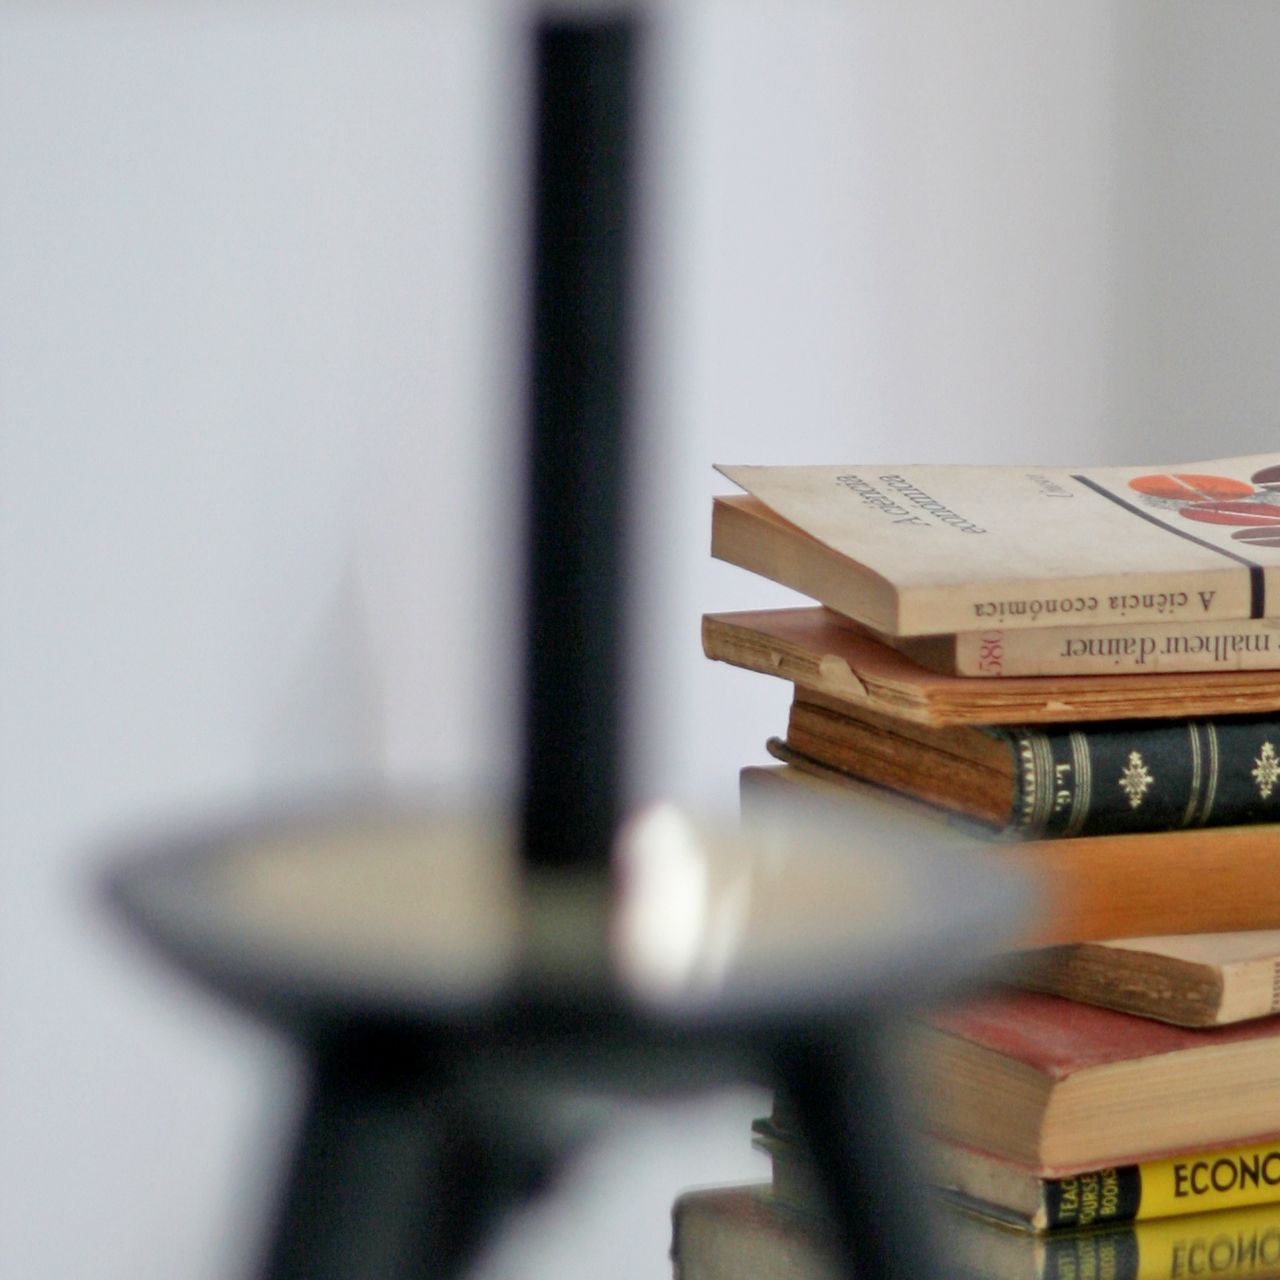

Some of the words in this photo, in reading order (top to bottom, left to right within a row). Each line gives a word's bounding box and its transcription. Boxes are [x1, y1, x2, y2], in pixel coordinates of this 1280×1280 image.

[974, 598, 1099, 623] económica
[1108, 596, 1188, 617] ciência
[1198, 591, 1217, 612] A
[1060, 637, 1156, 665] d'aimer
[1161, 631, 1271, 662] malheur
[1055, 764, 1071, 785] L.
[1055, 790, 1071, 811] G.
[1059, 1178, 1078, 1218] TEAC
